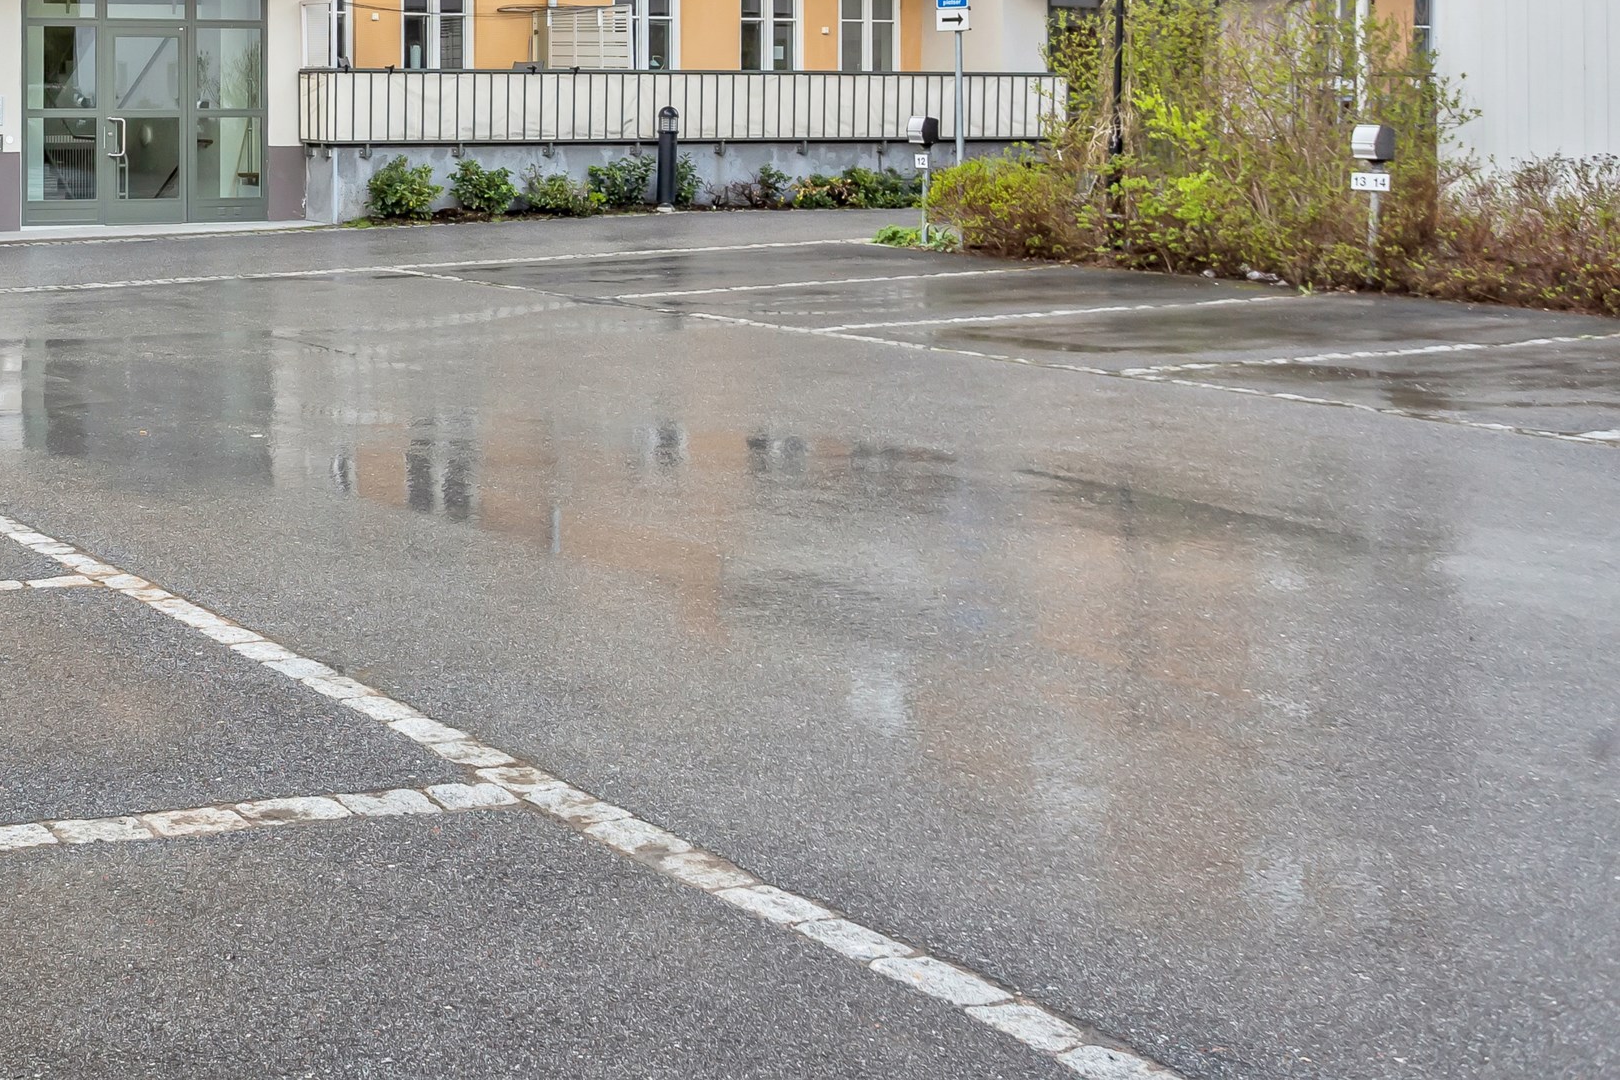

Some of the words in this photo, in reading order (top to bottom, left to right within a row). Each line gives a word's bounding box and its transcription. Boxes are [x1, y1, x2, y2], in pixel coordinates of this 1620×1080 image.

[917, 157, 926, 166] 12
[1354, 176, 1367, 187] 13
[1373, 178, 1386, 188] 14
